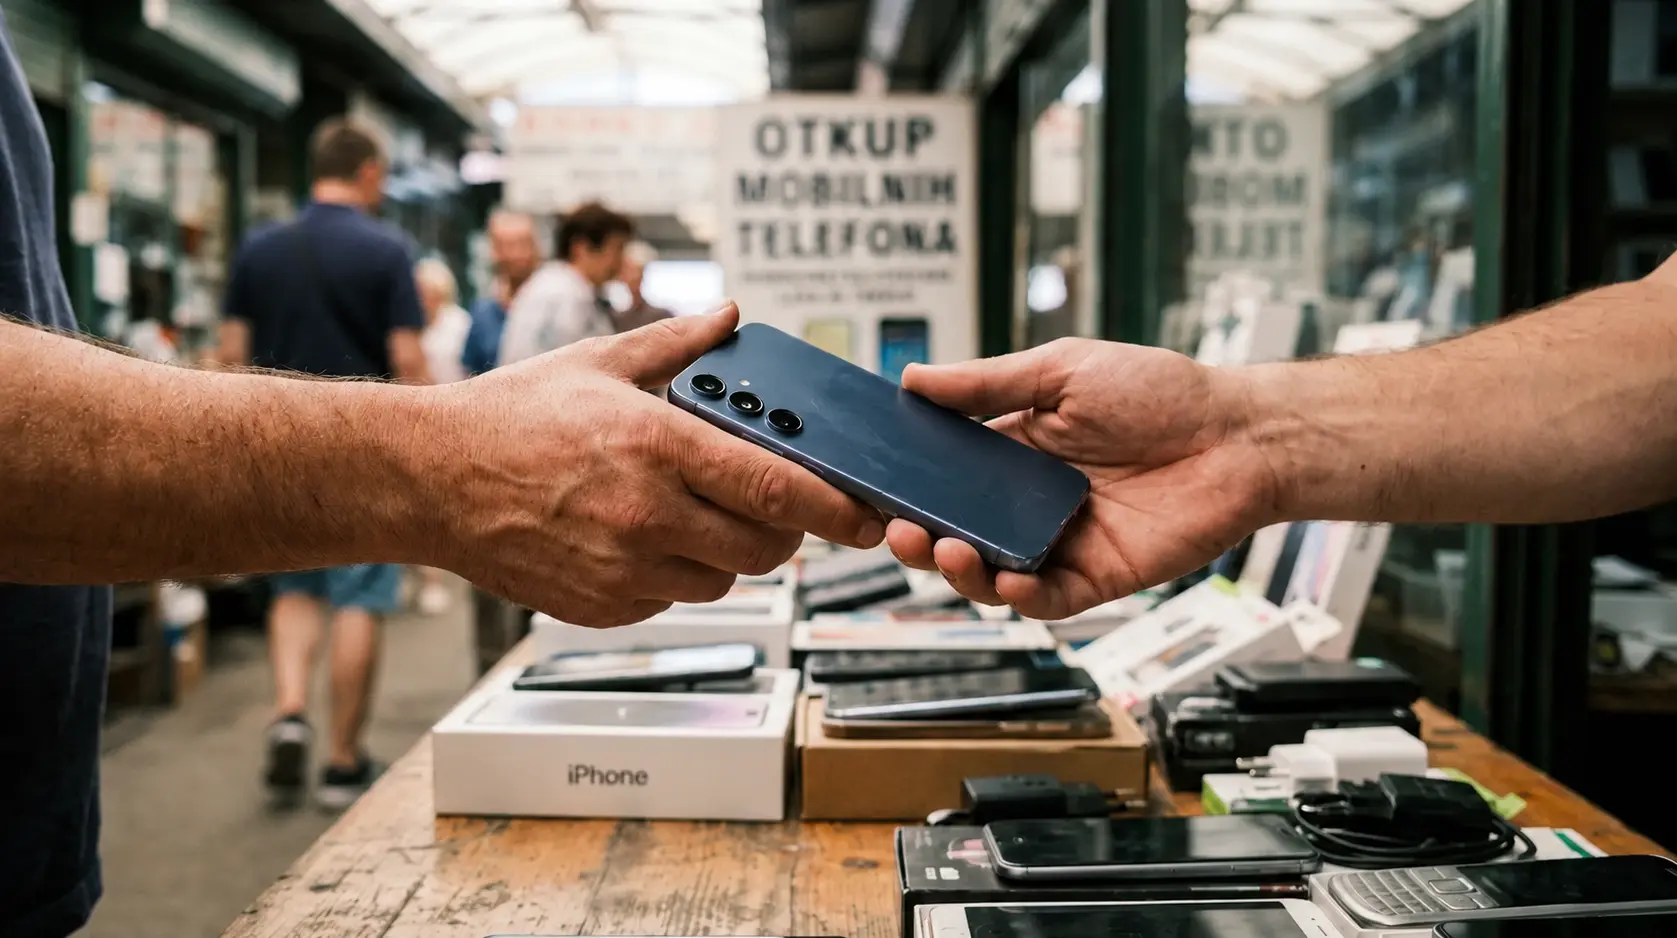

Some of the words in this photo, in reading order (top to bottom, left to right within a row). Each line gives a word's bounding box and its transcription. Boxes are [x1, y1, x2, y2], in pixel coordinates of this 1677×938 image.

[754, 117, 935, 157] OTKUP
[737, 172, 957, 206] MOBILNIH
[738, 220, 958, 256] TELEFONA
[567, 764, 649, 786] iPhone
